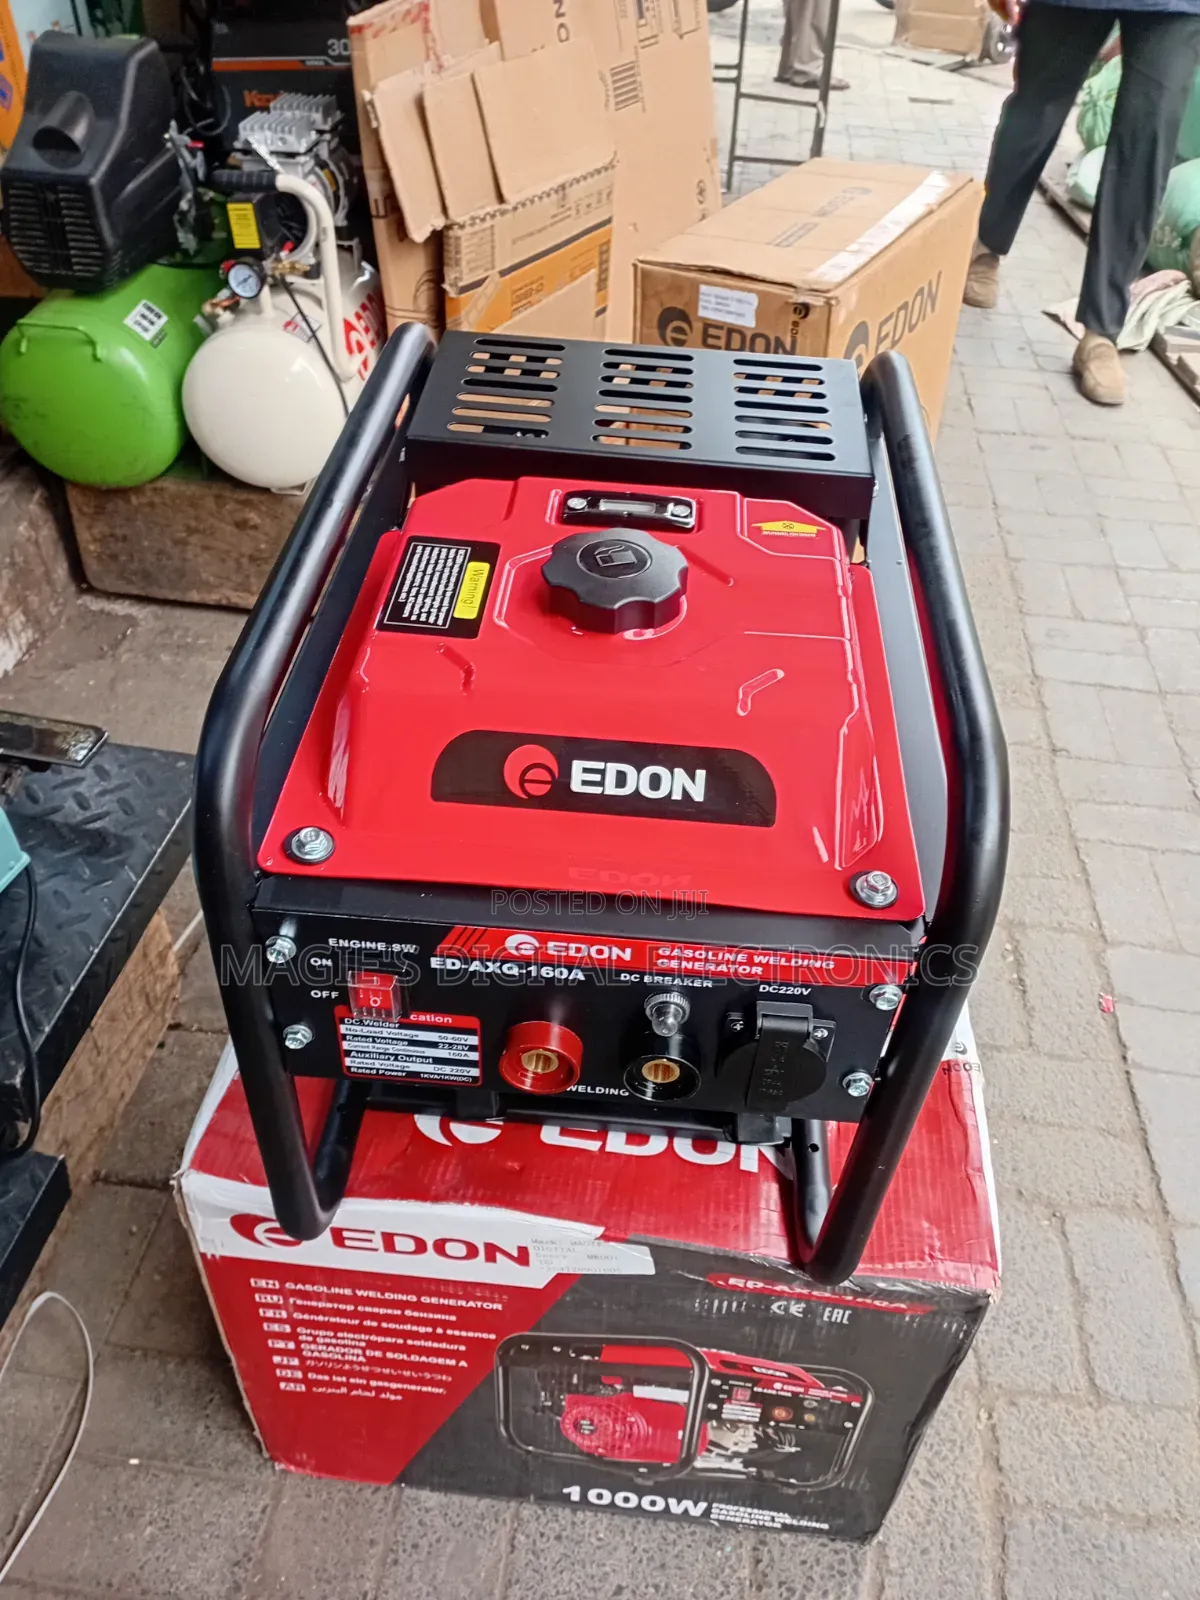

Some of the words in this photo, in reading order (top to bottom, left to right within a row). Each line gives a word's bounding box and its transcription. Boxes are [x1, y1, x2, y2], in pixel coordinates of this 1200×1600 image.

[875, 269, 942, 355] EDON
[702, 322, 798, 355] EDON
[570, 759, 706, 802] EDON
[546, 941, 632, 961] EDON
[658, 946, 748, 962] GASOLINE
[753, 954, 836, 969] WELDING
[310, 957, 334, 967] ON
[429, 957, 586, 982] ED-AXQ-160A
[656, 959, 764, 975] GENERATOR
[620, 973, 640, 983] DC
[643, 975, 713, 988] BREAKER
[310, 989, 340, 1000] OFF
[758, 984, 812, 996] DC220V
[410, 1013, 453, 1024] cation
[346, 1035, 373, 1043] Rated
[374, 1038, 409, 1046] Voltage
[437, 1042, 470, 1051] 22-28V
[386, 1031, 420, 1039] Voltage
[350, 1051, 396, 1062] Auxiliary
[398, 1055, 434, 1064] Output
[350, 1059, 376, 1067] Rated
[378, 1062, 411, 1070] Voltage
[449, 1067, 472, 1075] 220V
[350, 1067, 377, 1075] Rated
[379, 1069, 407, 1077] Power
[566, 1084, 630, 1097] WELDING
[330, 1226, 530, 1268] EDON
[285, 1282, 354, 1297] GASOLINE
[355, 1289, 418, 1303] WELDING
[420, 1295, 503, 1311] GENERATOR
[296, 1327, 334, 1337] Grupo
[363, 1319, 378, 1328] de
[446, 1329, 497, 1340] essence
[316, 1337, 366, 1347] gasolina
[301, 1343, 363, 1356] GERADOR
[365, 1350, 383, 1358] DE
[386, 1351, 457, 1367] SOLDAGEM
[458, 1360, 468, 1368] A
[302, 1350, 367, 1363] GASOLINA
[307, 1372, 330, 1381] Das
[332, 1374, 347, 1382] ist
[349, 1377, 368, 1385] ein
[562, 1484, 708, 1518] 1000W
[709, 1513, 782, 1529] GENERATOR
[711, 1508, 771, 1521] GASOLINE
[774, 1516, 830, 1529] WELDING
